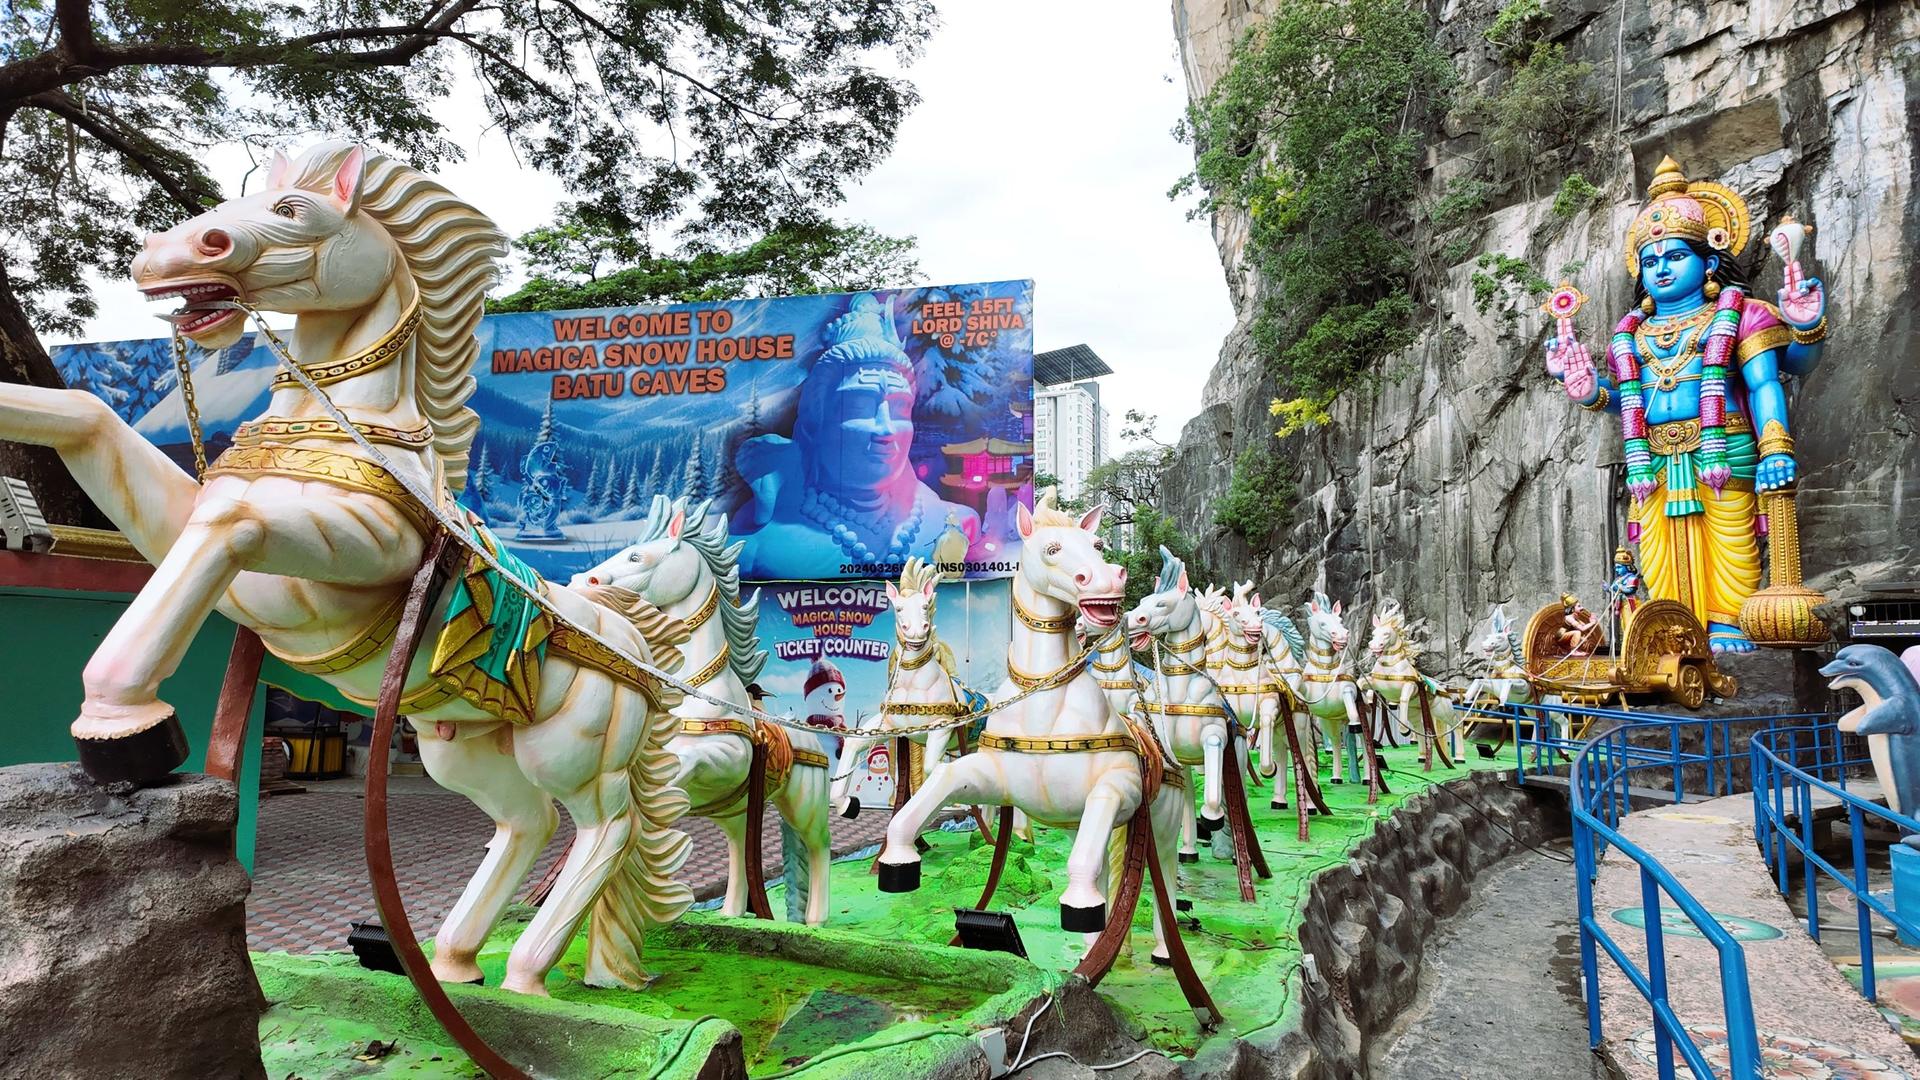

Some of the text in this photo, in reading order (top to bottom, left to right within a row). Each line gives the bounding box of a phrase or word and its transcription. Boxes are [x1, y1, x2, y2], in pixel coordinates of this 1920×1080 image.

[922, 298, 1014, 318] FEEL 15FT
[553, 310, 732, 342] WELCOME TO
[912, 314, 1024, 334] LORD SHIVA
[940, 333, 955, 348] @
[492, 335, 794, 373] MAGICA SNOW HOUSE
[553, 368, 726, 399] BATU CAVES
[776, 588, 889, 609] WELCOME
[792, 611, 874, 625] MAGICA SNOW
[813, 624, 853, 636] HOUSE
[775, 639, 889, 658] TICKET COUNTER
